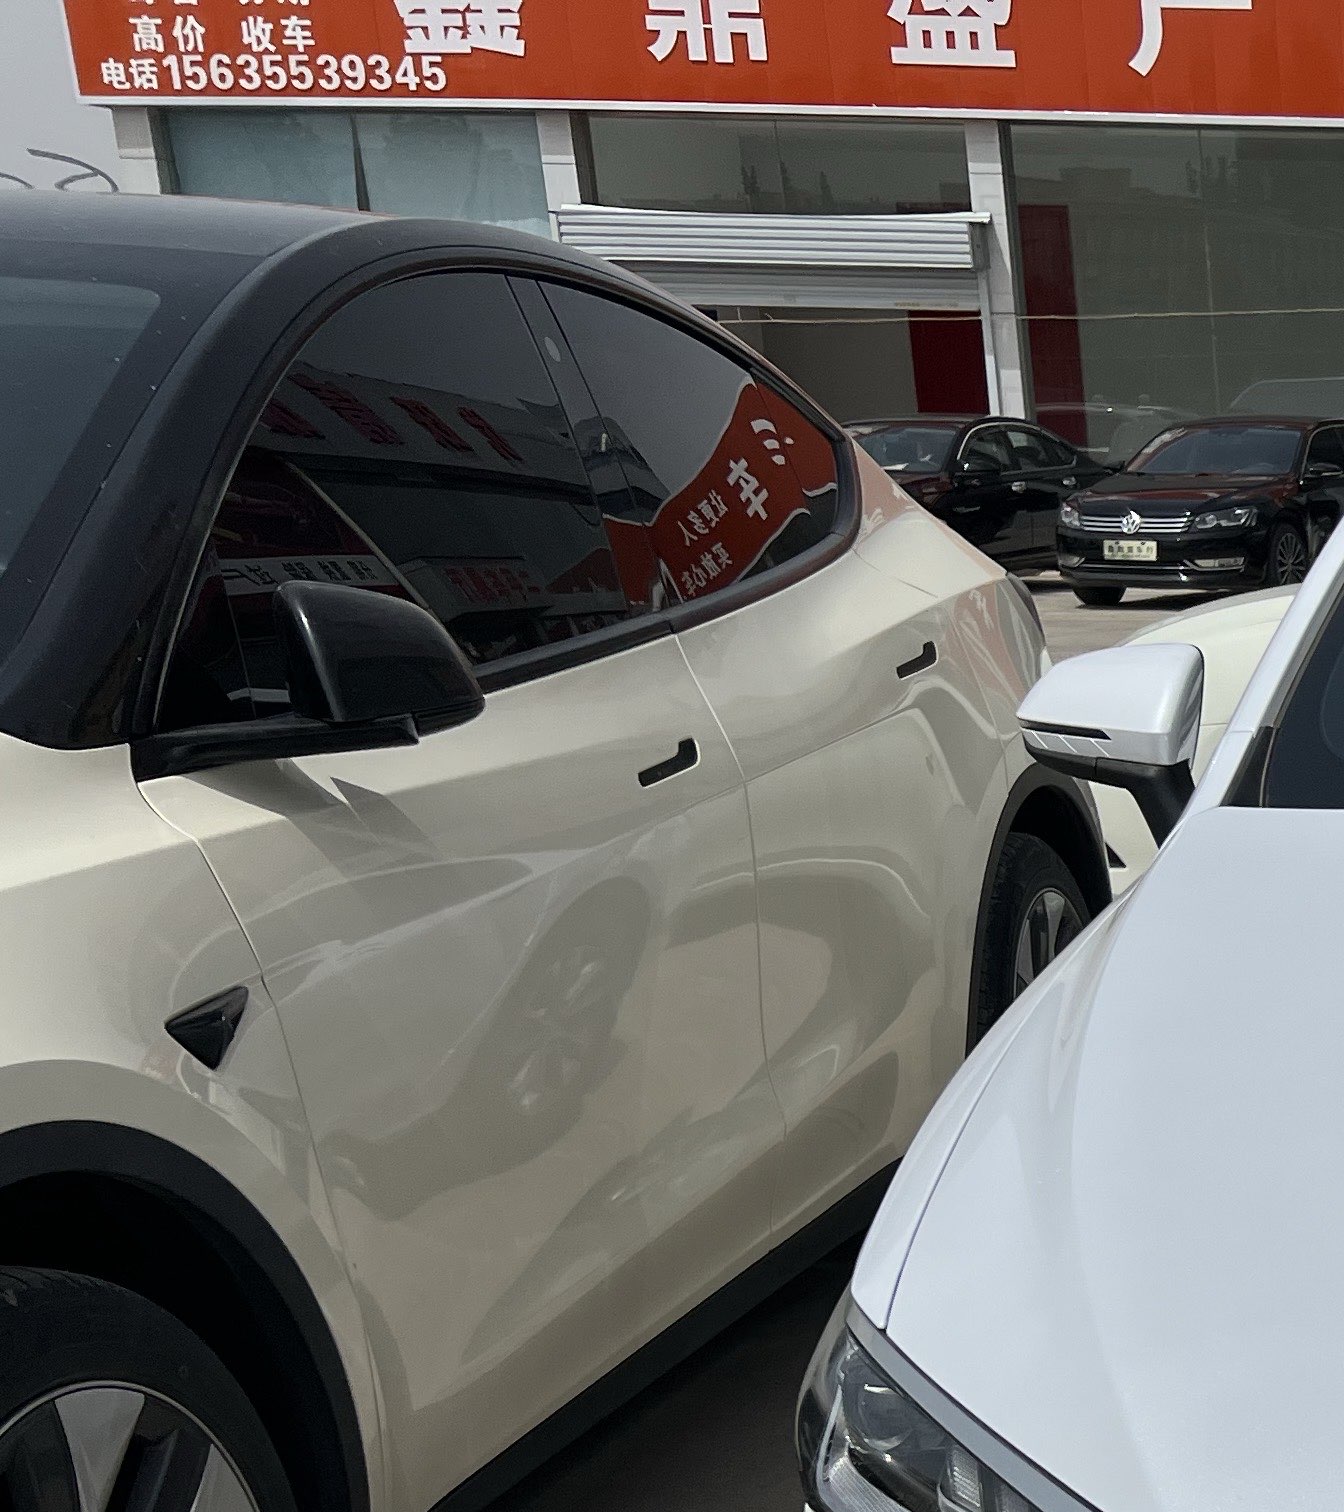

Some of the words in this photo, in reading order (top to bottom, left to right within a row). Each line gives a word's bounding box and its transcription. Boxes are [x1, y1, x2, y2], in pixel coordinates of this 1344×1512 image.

[129, 15, 206, 52] 高价
[241, 15, 316, 52] 收车
[101, 54, 446, 91] 电话15635539345
